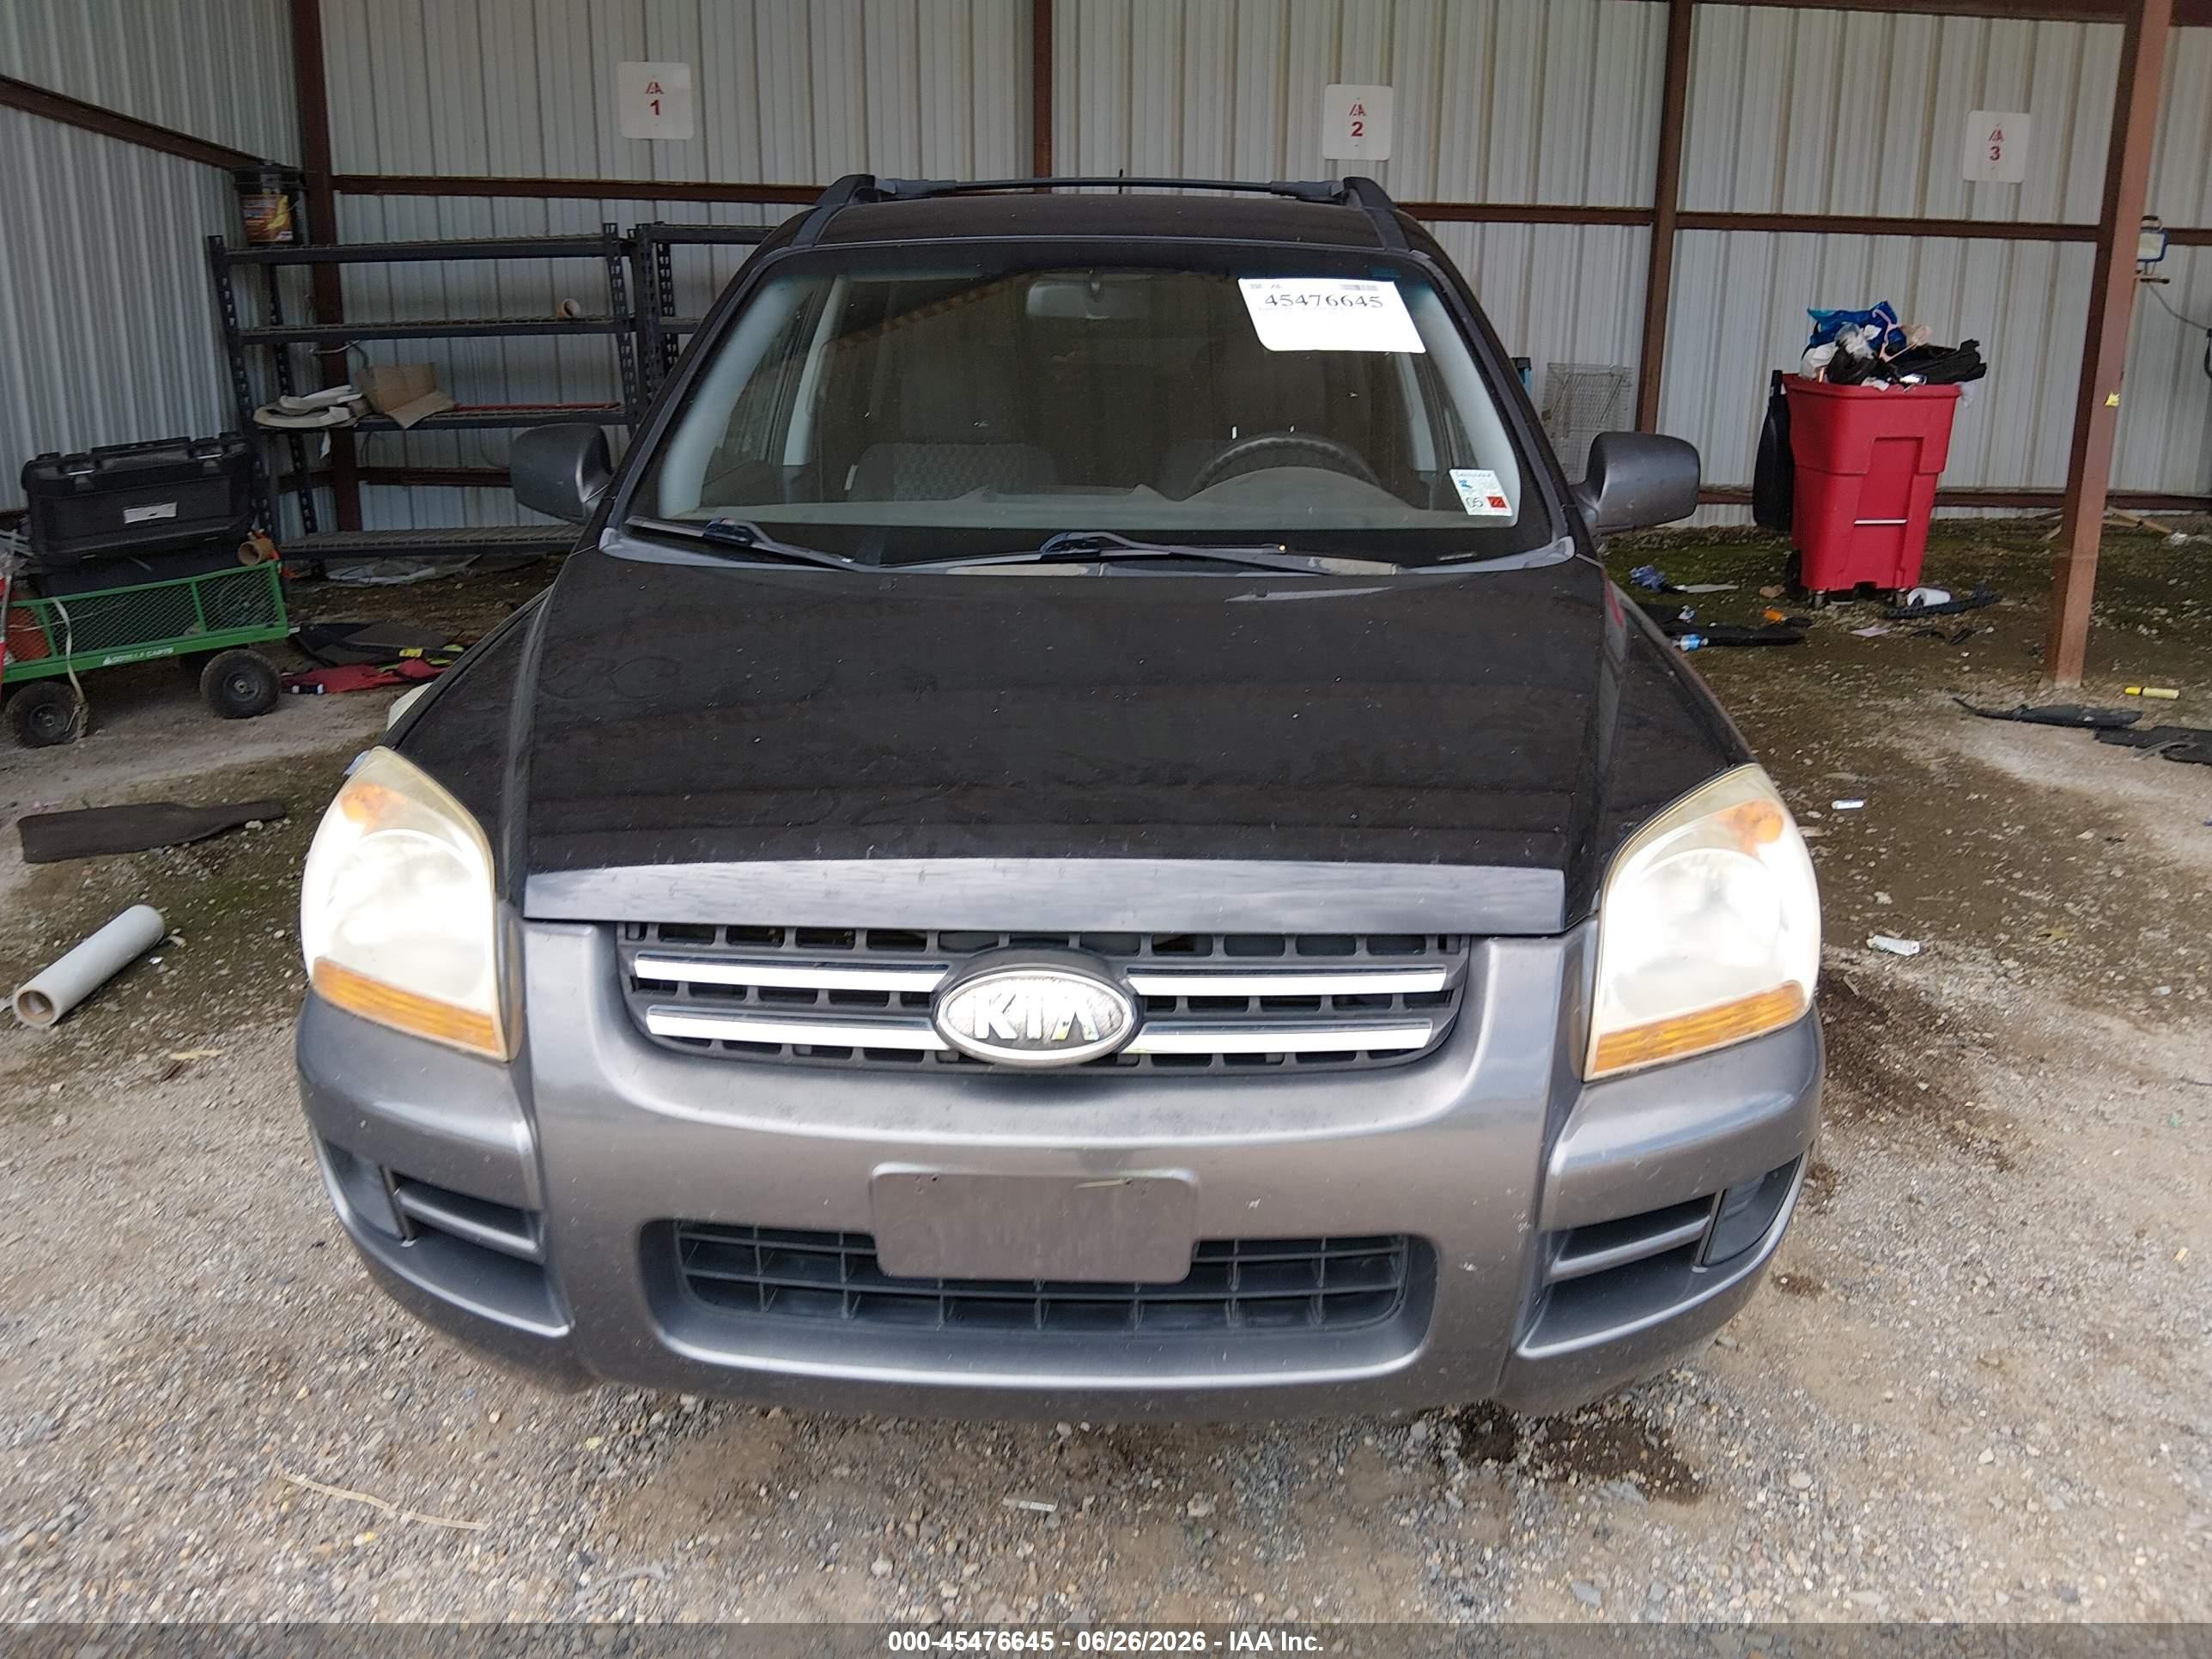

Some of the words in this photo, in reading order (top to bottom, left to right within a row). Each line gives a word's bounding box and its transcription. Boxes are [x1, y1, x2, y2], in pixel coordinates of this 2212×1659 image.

[650, 100, 659, 115] 1
[1351, 121, 1364, 137] 2
[1990, 146, 2001, 161] 3
[1265, 294, 1383, 308] 45476645
[974, 993, 1100, 1041] KIA
